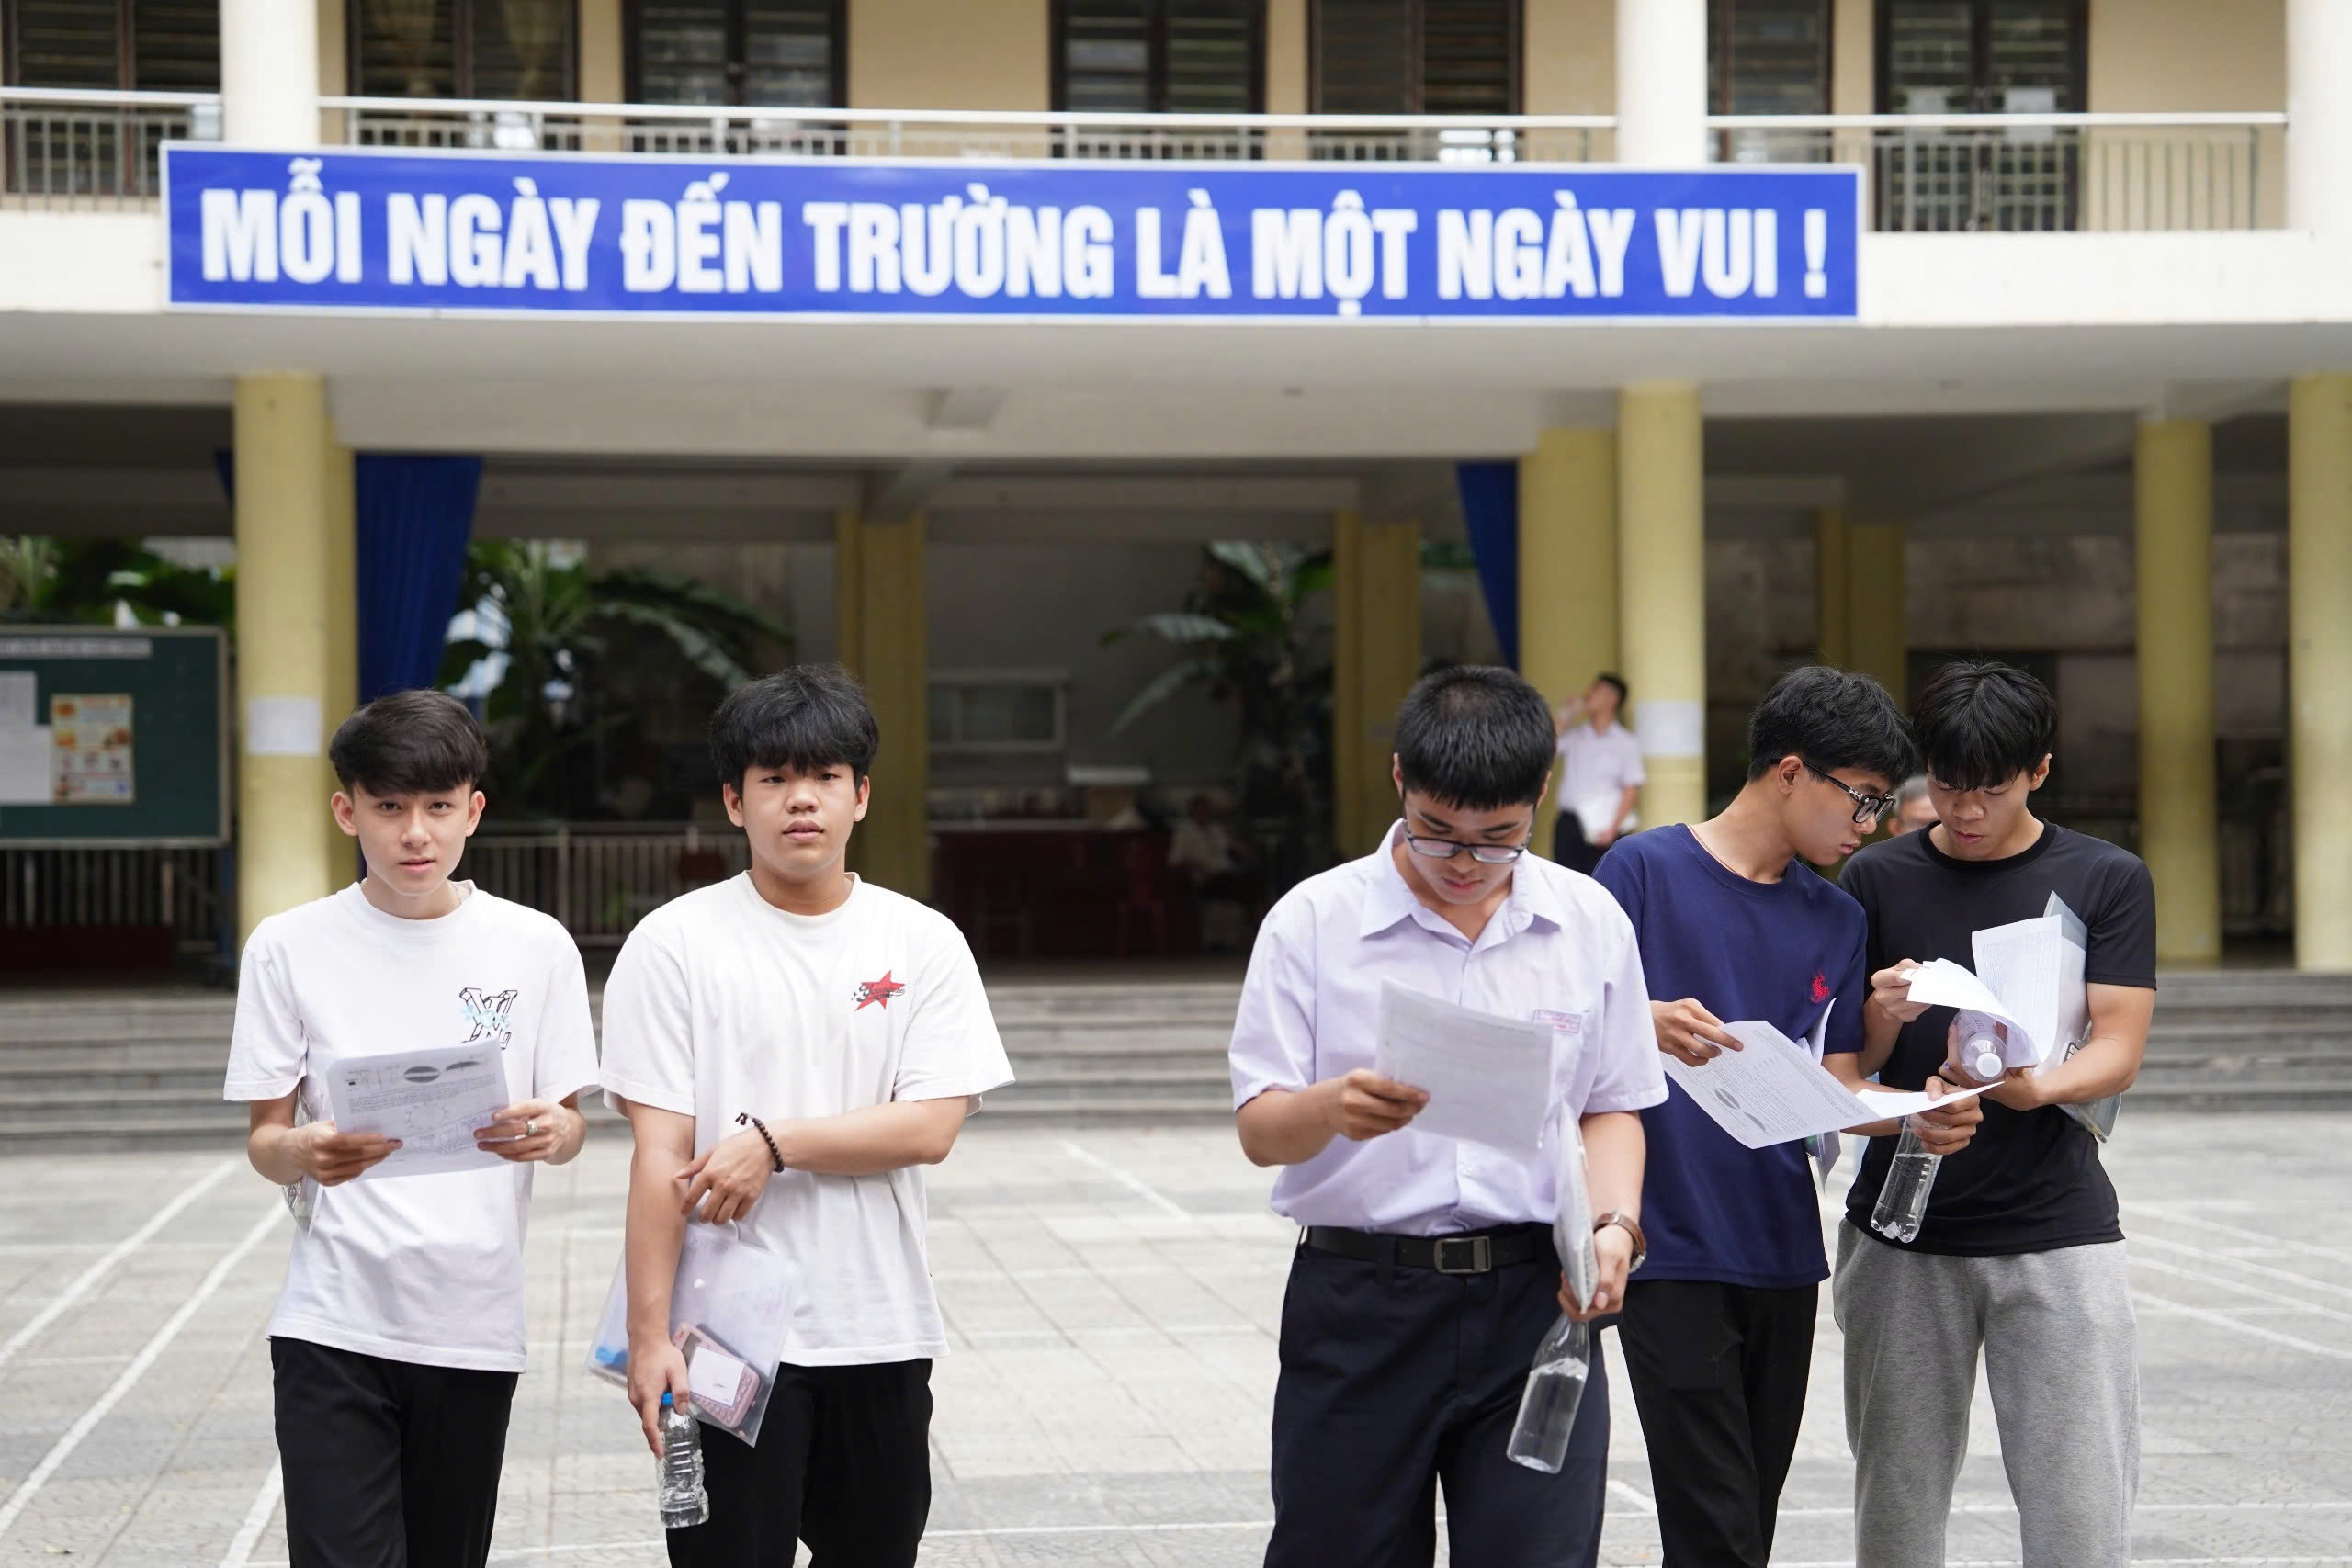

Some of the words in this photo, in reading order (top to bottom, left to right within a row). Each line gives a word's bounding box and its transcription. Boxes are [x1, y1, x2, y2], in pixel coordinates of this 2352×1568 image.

[200, 157, 363, 283] MỖI
[387, 176, 601, 291] NGÀY
[619, 172, 783, 293] ĐẾN
[802, 183, 1114, 299] TRƯỜNG
[1136, 188, 1232, 299] LÀ
[1251, 190, 1418, 316] MỘT
[1436, 190, 1636, 300] NGÀY
[1654, 208, 1778, 299] VUI
[1804, 209, 1827, 299] !
